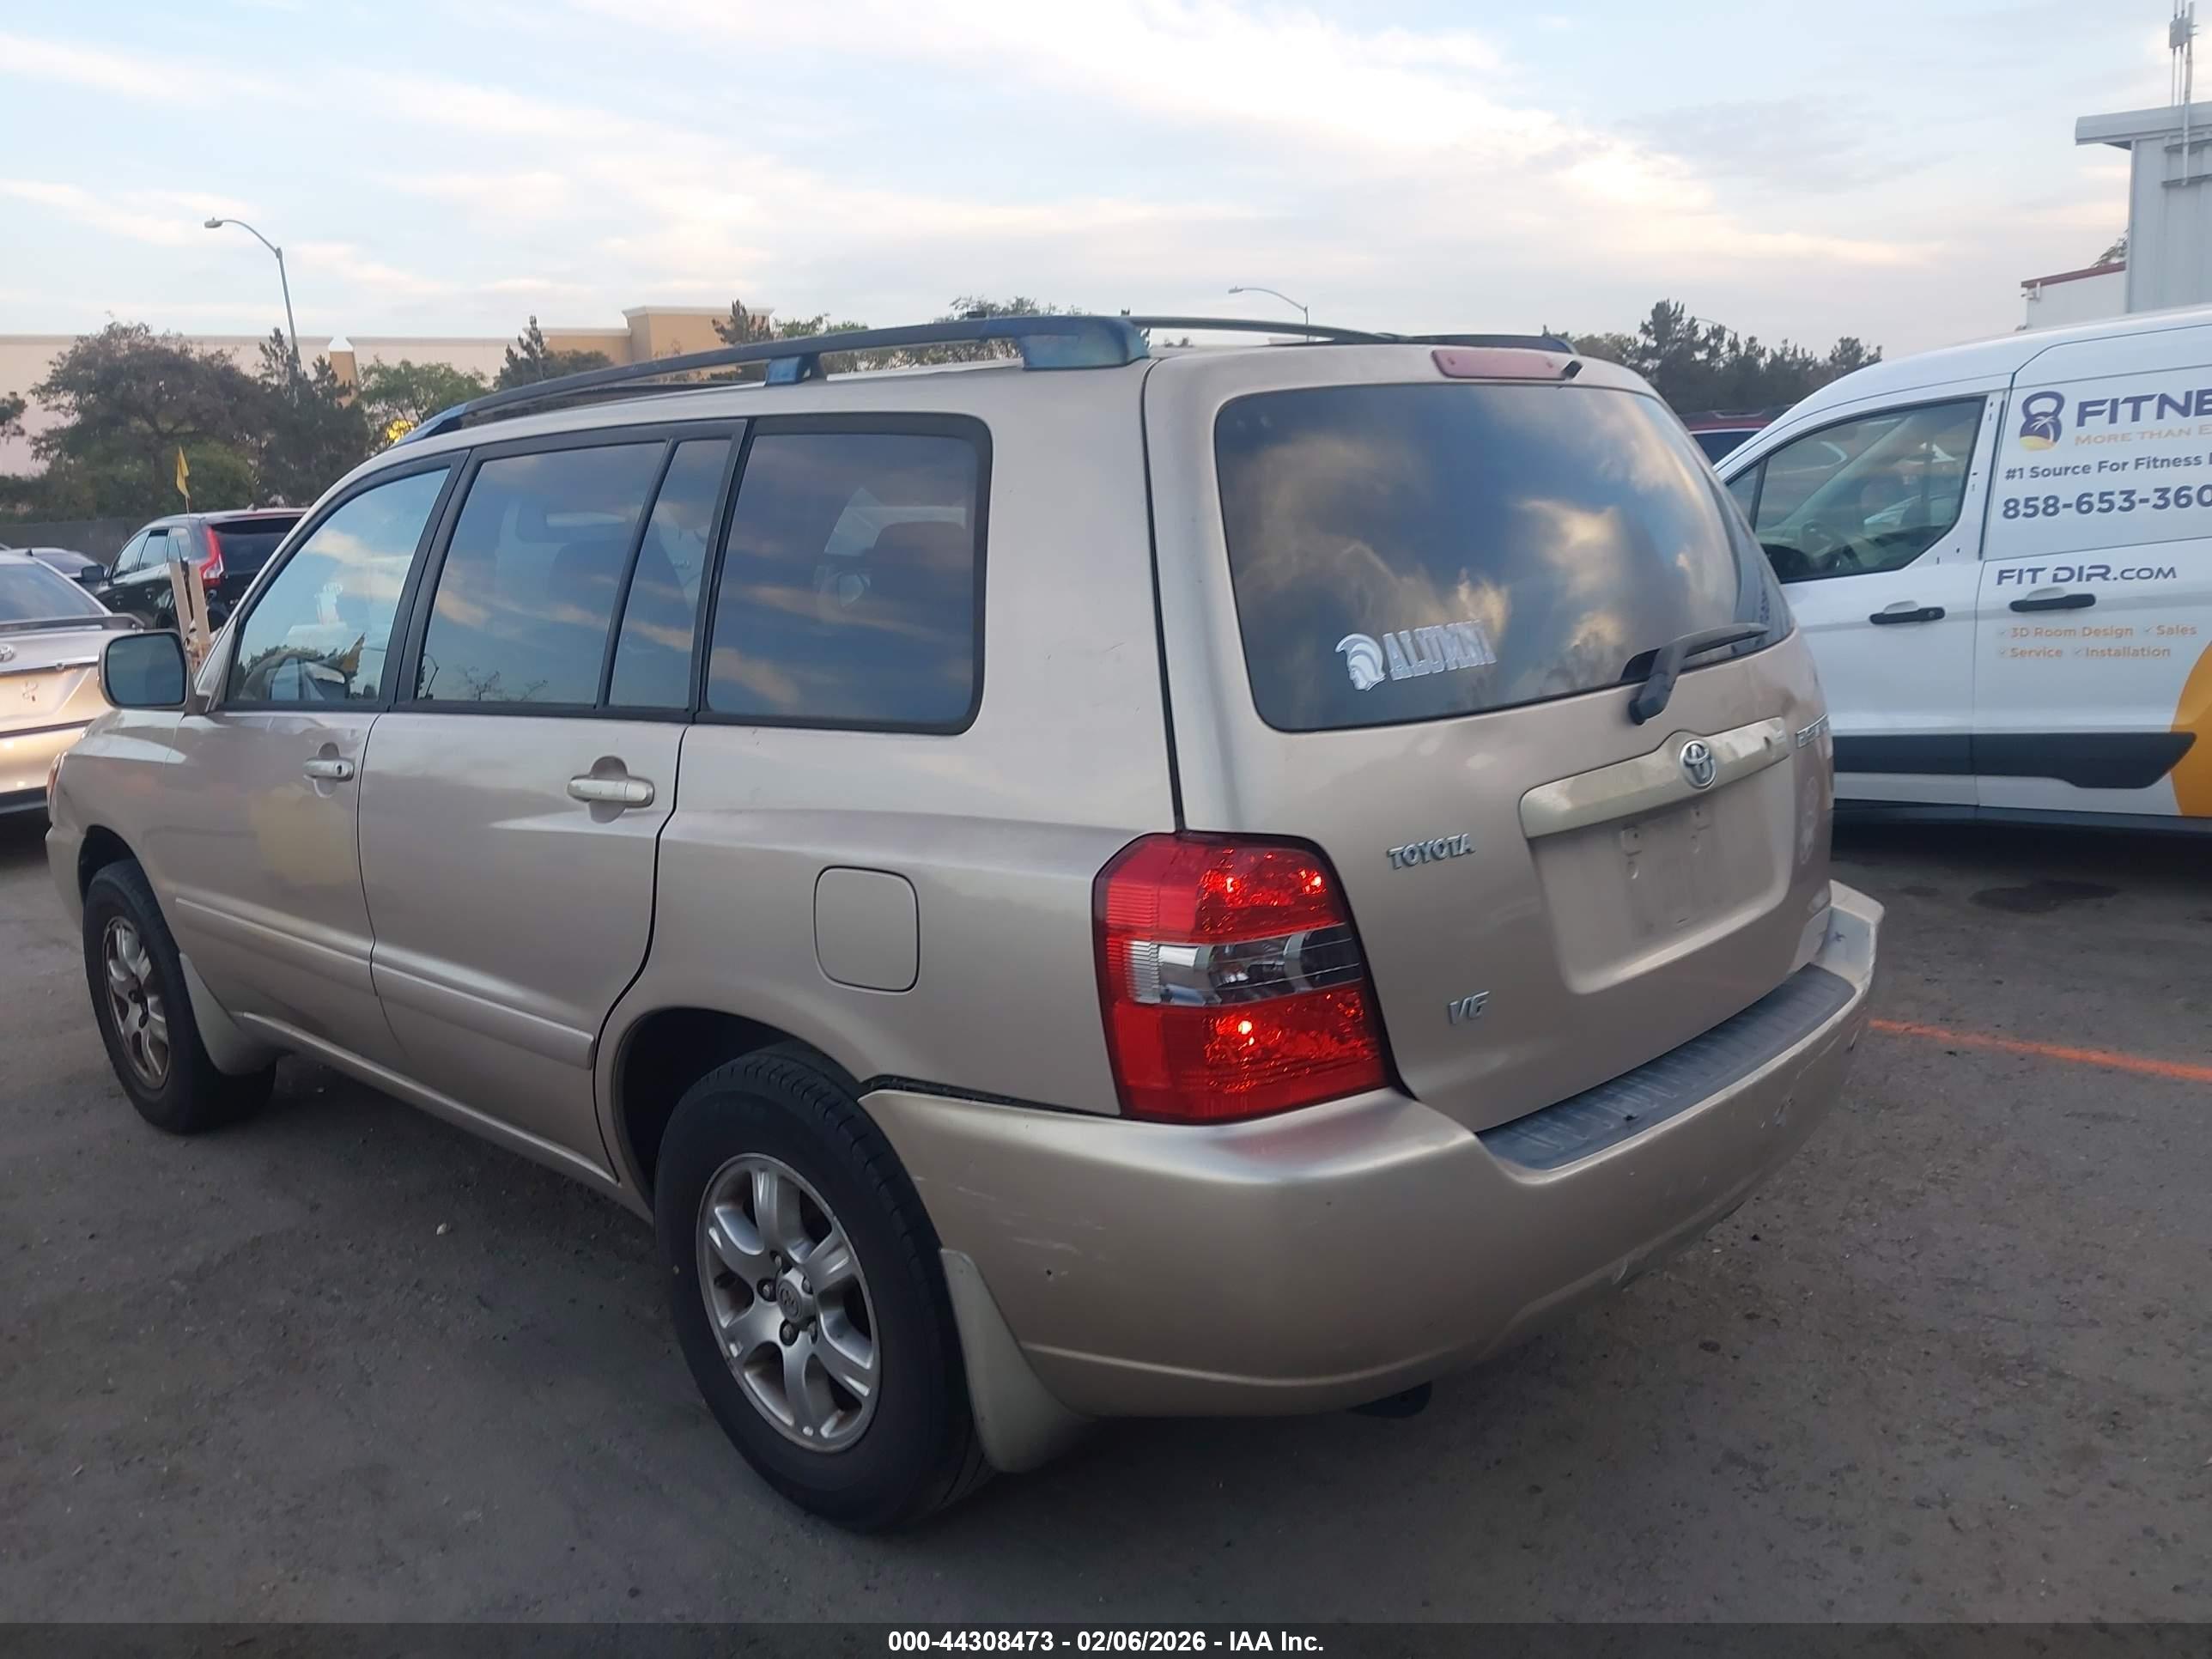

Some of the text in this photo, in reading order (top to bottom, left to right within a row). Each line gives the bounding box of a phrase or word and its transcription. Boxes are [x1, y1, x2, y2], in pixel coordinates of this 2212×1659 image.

[2076, 388, 2212, 428] FITNE
[2075, 431, 2132, 446] MORE
[2137, 427, 2191, 441] THAN
[2005, 467, 2024, 481] #1
[2029, 461, 2092, 479] Source
[2097, 459, 2128, 474] For
[2134, 454, 2203, 471] Fitness
[2002, 484, 2212, 520] 858-653-360
[1996, 568, 2048, 586] FIT
[2009, 624, 2198, 640] 3D Room Design Sales
[2009, 646, 2172, 659] Service Installation
[1387, 833, 1476, 871] TOYOTA
[1448, 990, 1491, 1025] V6
